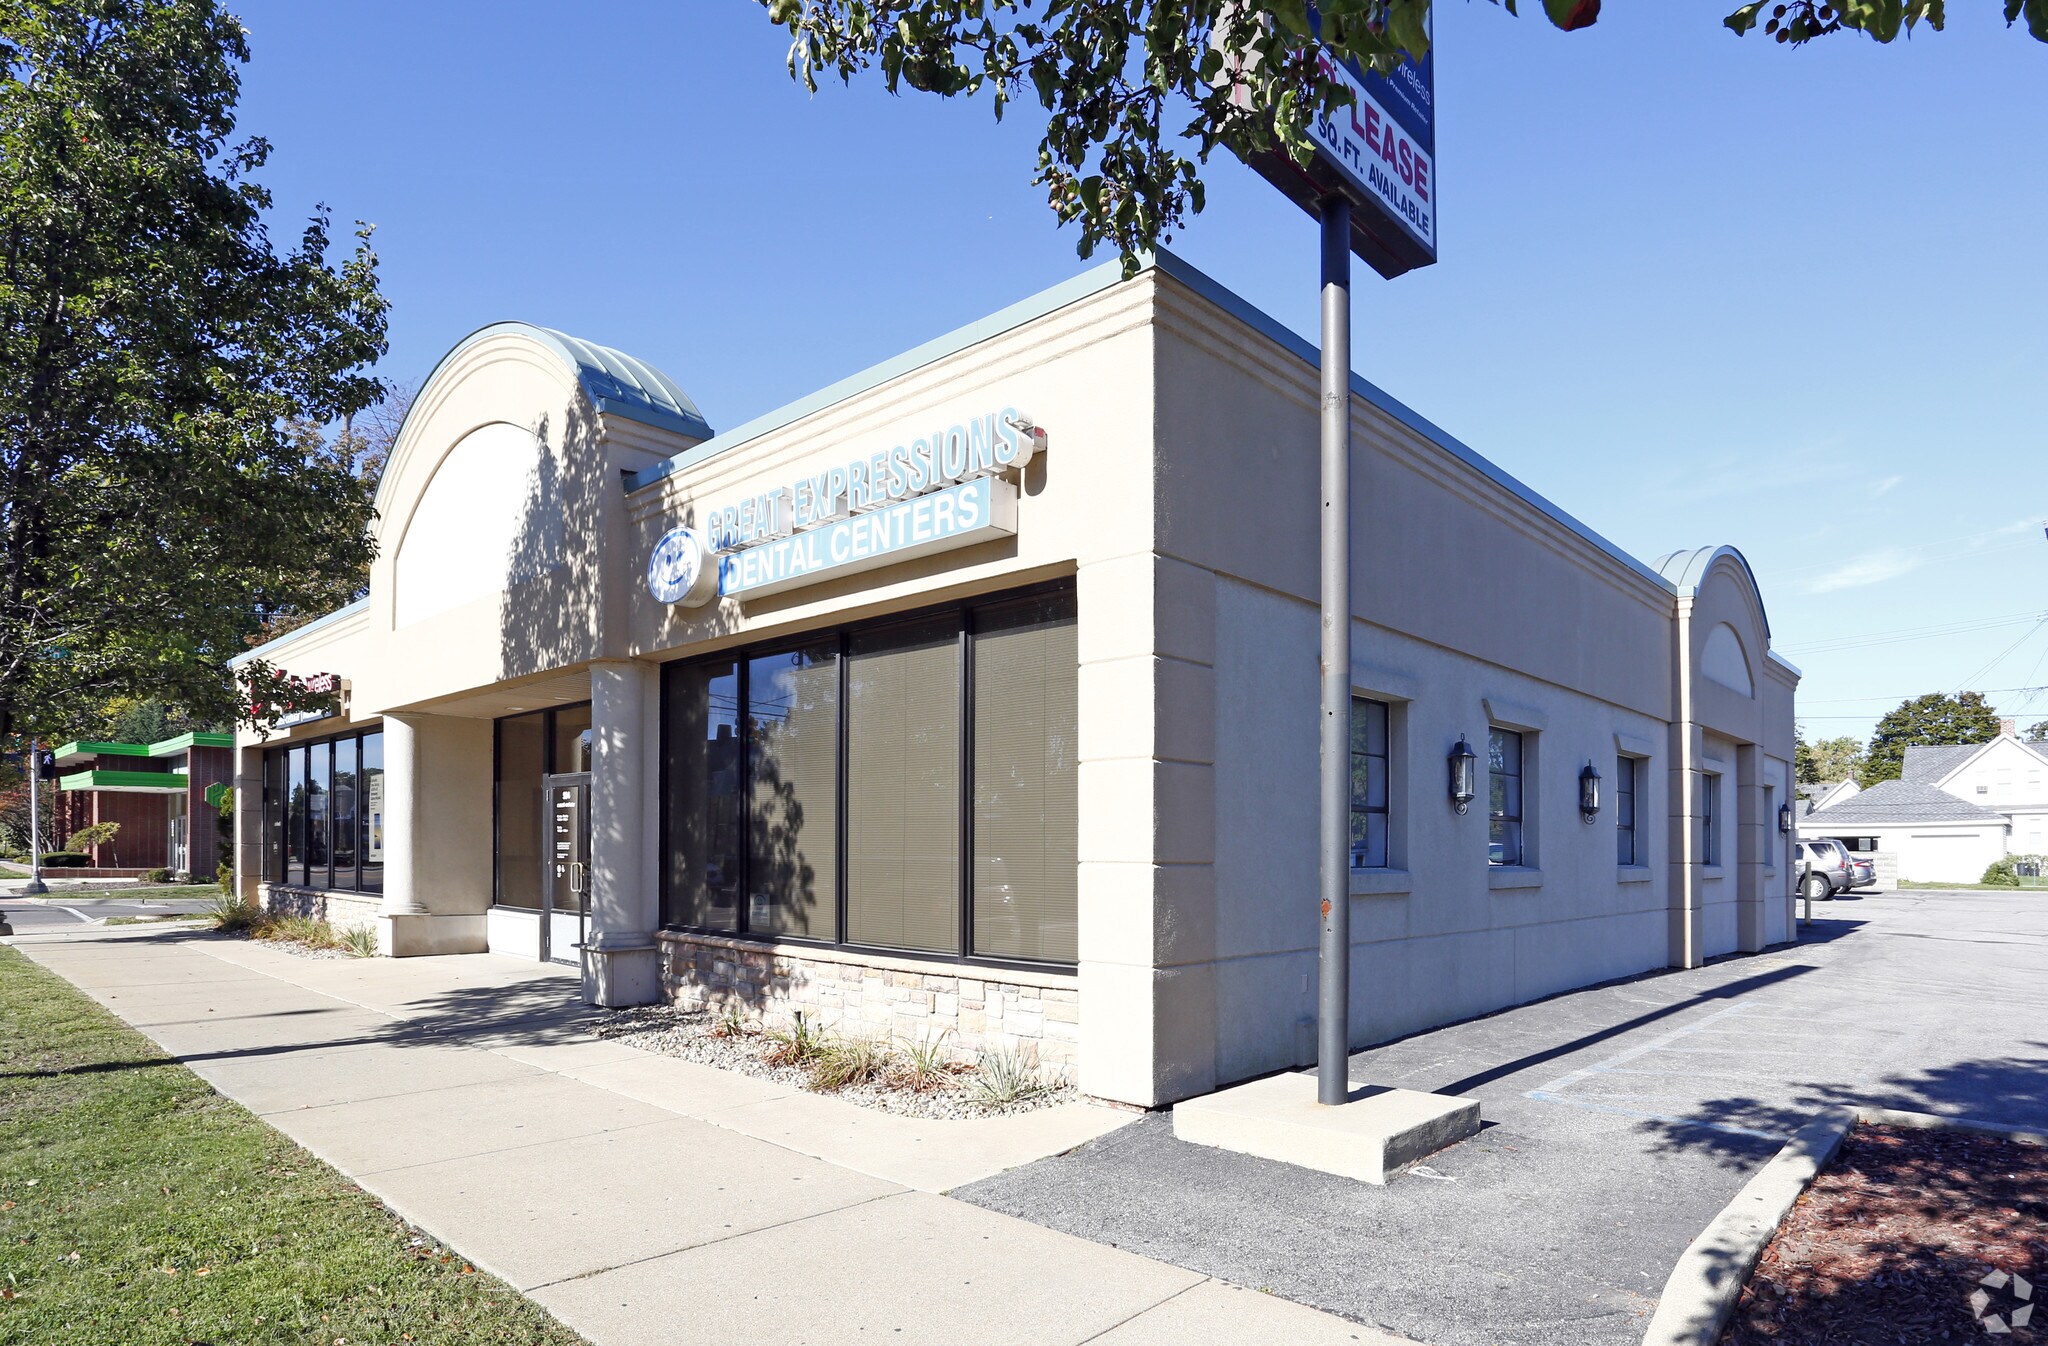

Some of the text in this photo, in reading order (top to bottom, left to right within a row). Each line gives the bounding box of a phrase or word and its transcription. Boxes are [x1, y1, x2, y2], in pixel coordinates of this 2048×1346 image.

[1350, 86, 1428, 203] LEASE
[1368, 162, 1429, 237] AVAILABLE
[707, 406, 1022, 554] GREAT EXPRESSIONS
[726, 485, 981, 590] DENTAL CENTERS
